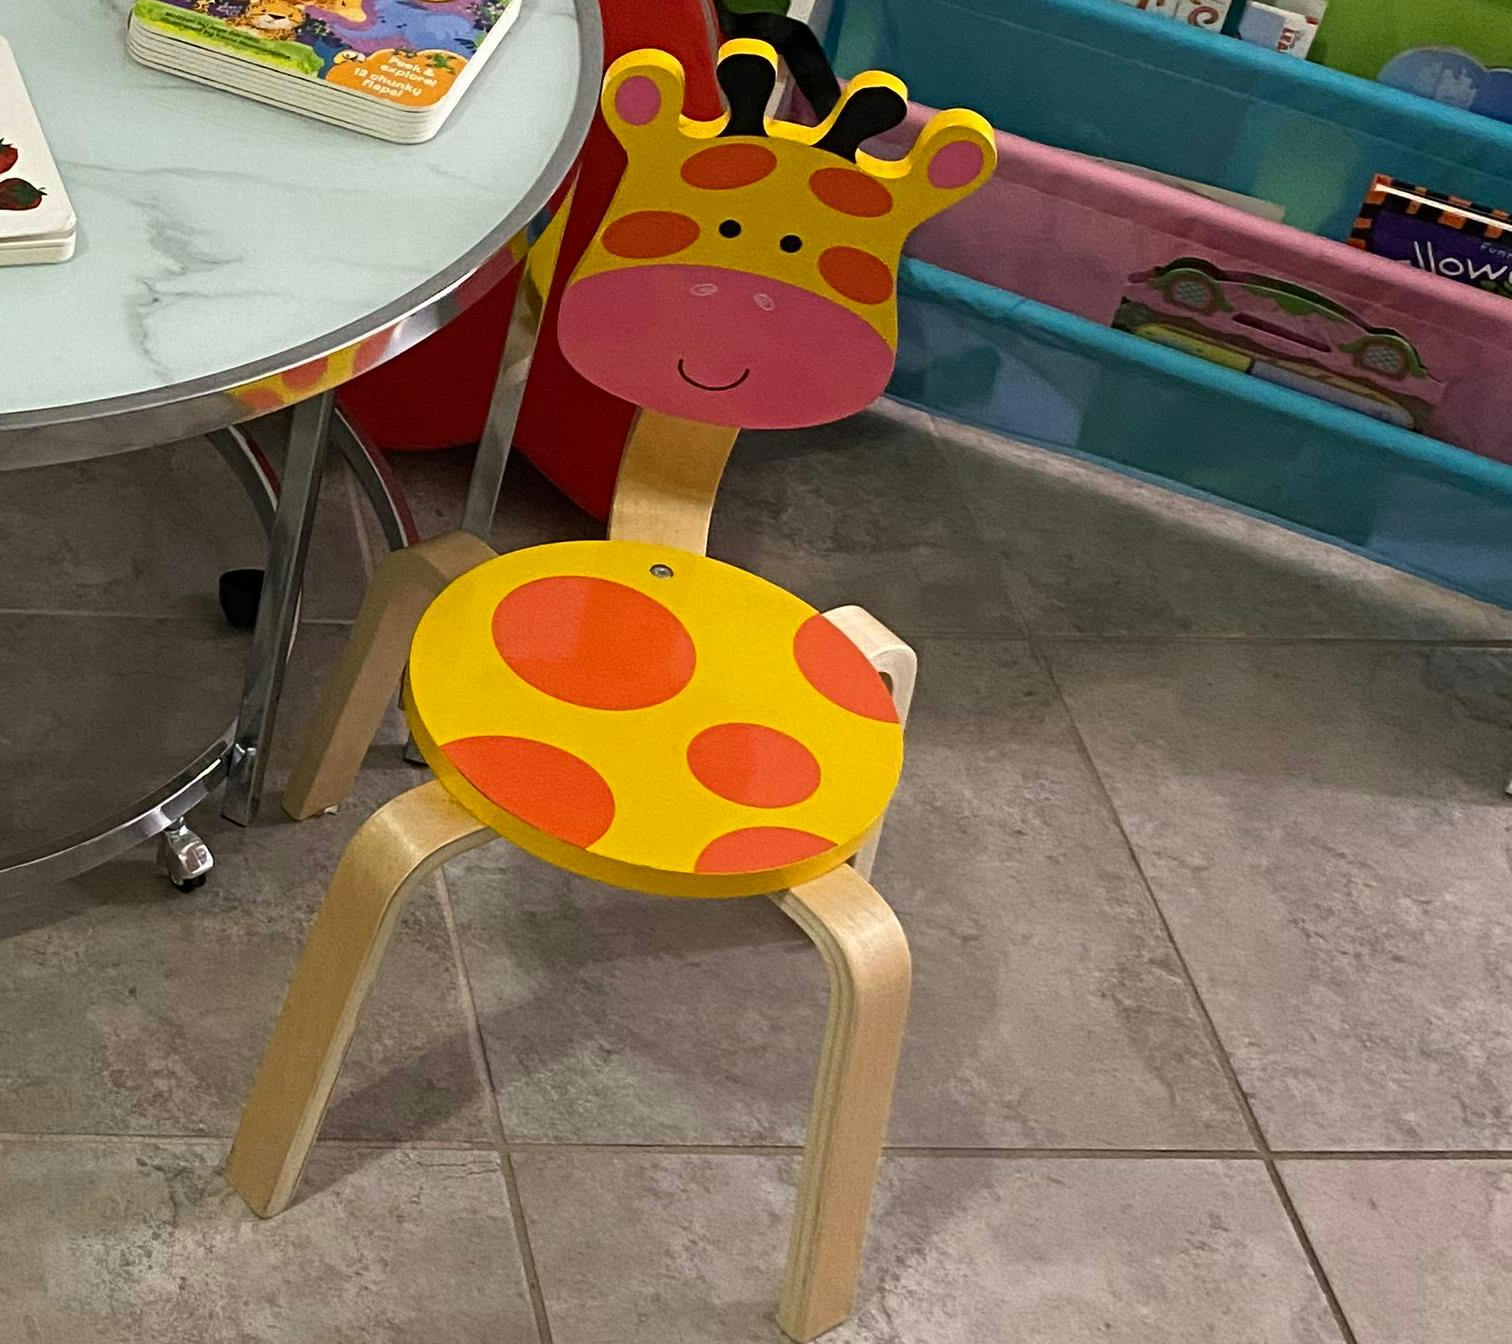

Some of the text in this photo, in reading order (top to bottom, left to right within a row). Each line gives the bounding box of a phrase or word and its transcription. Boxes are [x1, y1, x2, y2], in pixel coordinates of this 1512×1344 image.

[388, 55, 422, 73] Peek
[370, 73, 423, 96] chunky
[1408, 240, 1512, 281] llow
